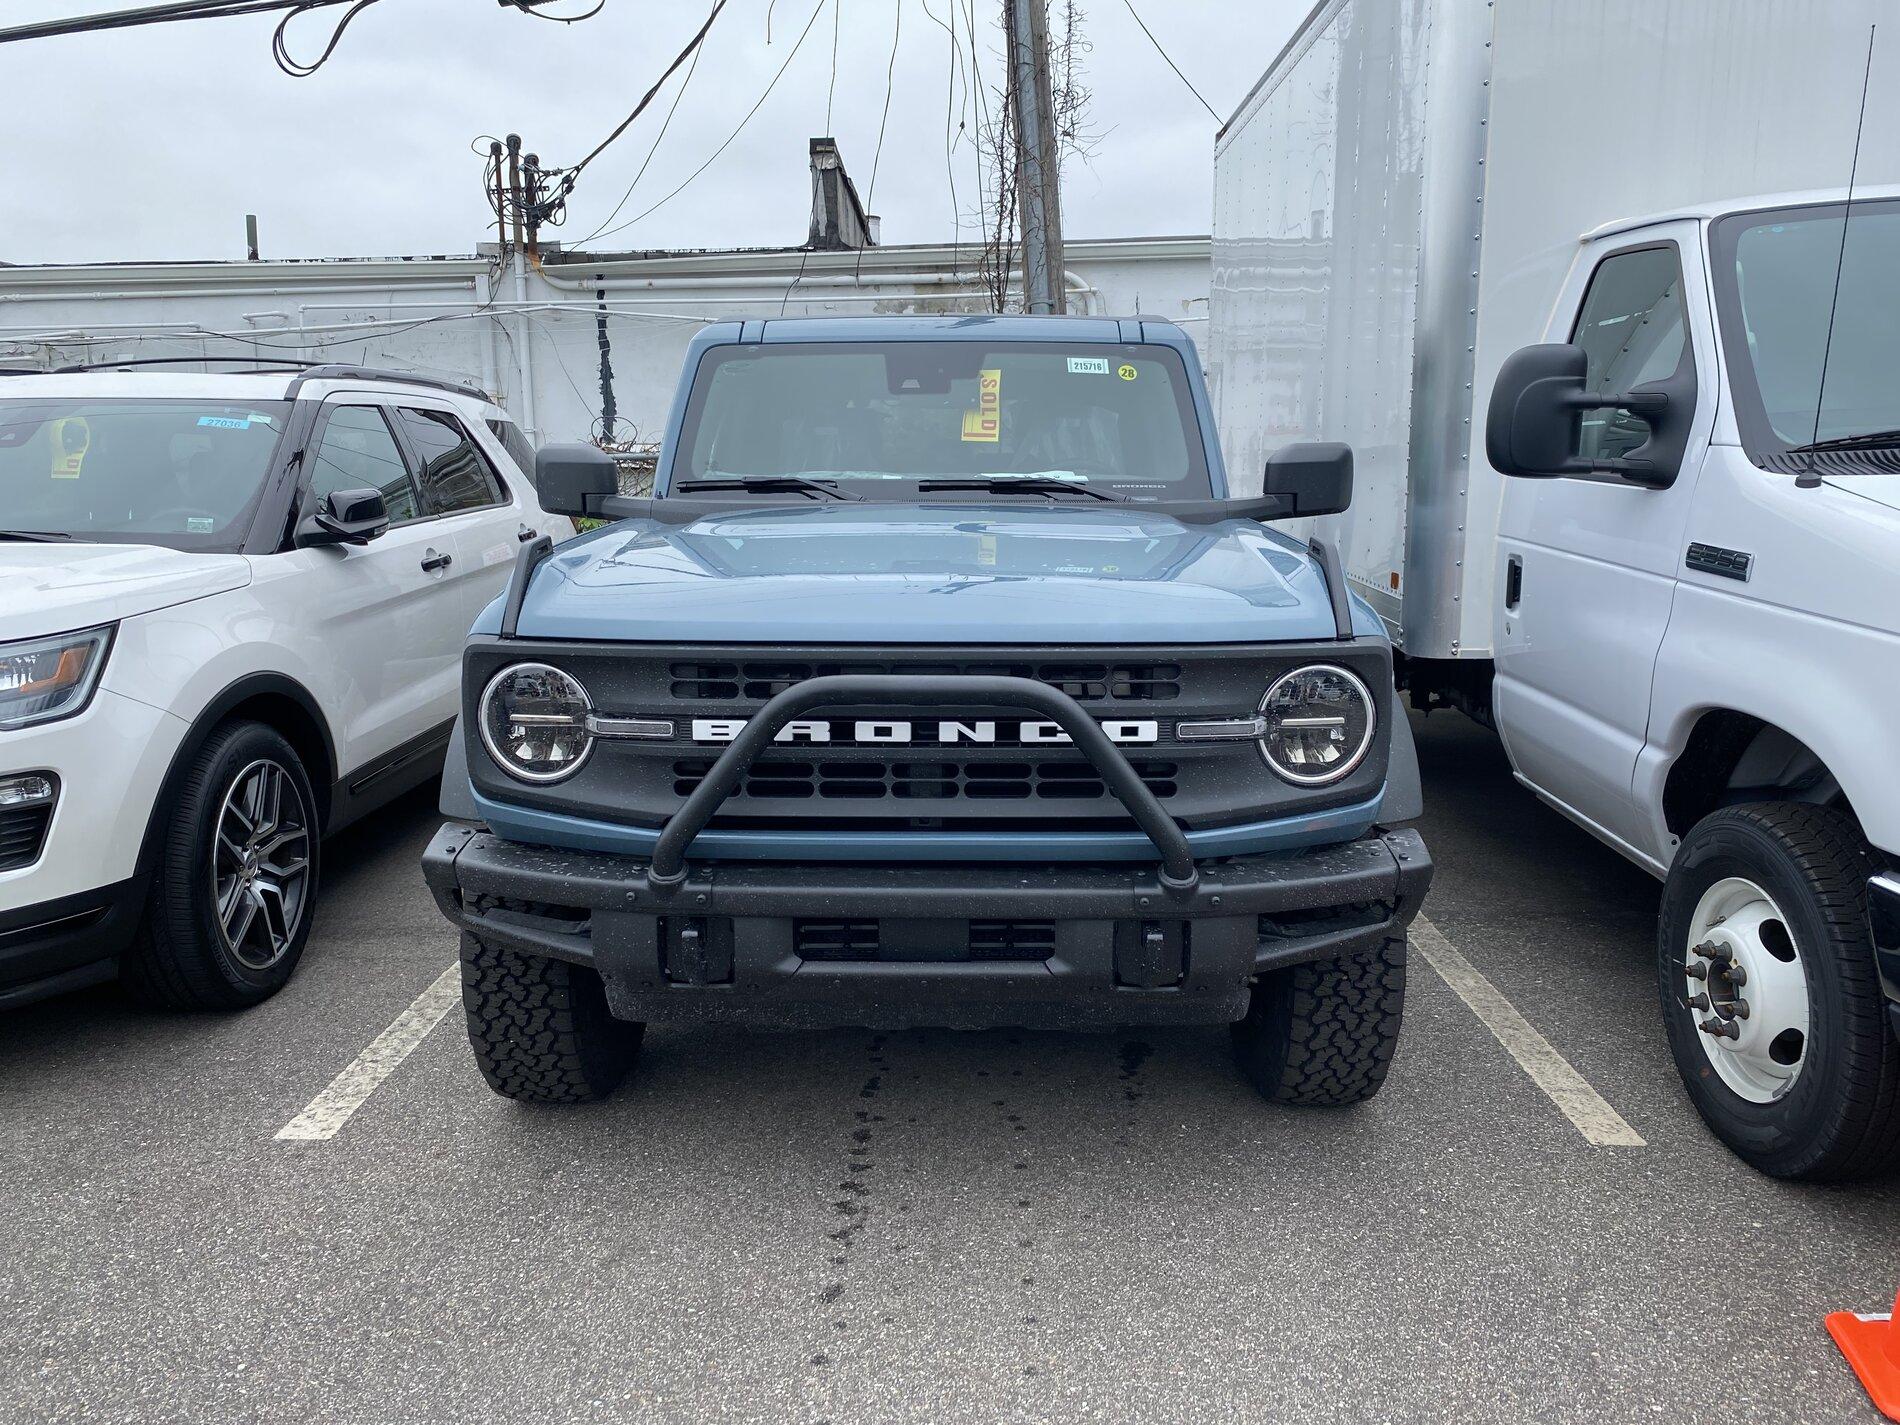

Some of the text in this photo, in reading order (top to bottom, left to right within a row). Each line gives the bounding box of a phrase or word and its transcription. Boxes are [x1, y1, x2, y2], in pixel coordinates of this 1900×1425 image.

[1121, 368, 1135, 378] 28
[981, 378, 997, 430] SOLD
[207, 418, 241, 428] 27036
[692, 719, 1158, 742] BRONCO
